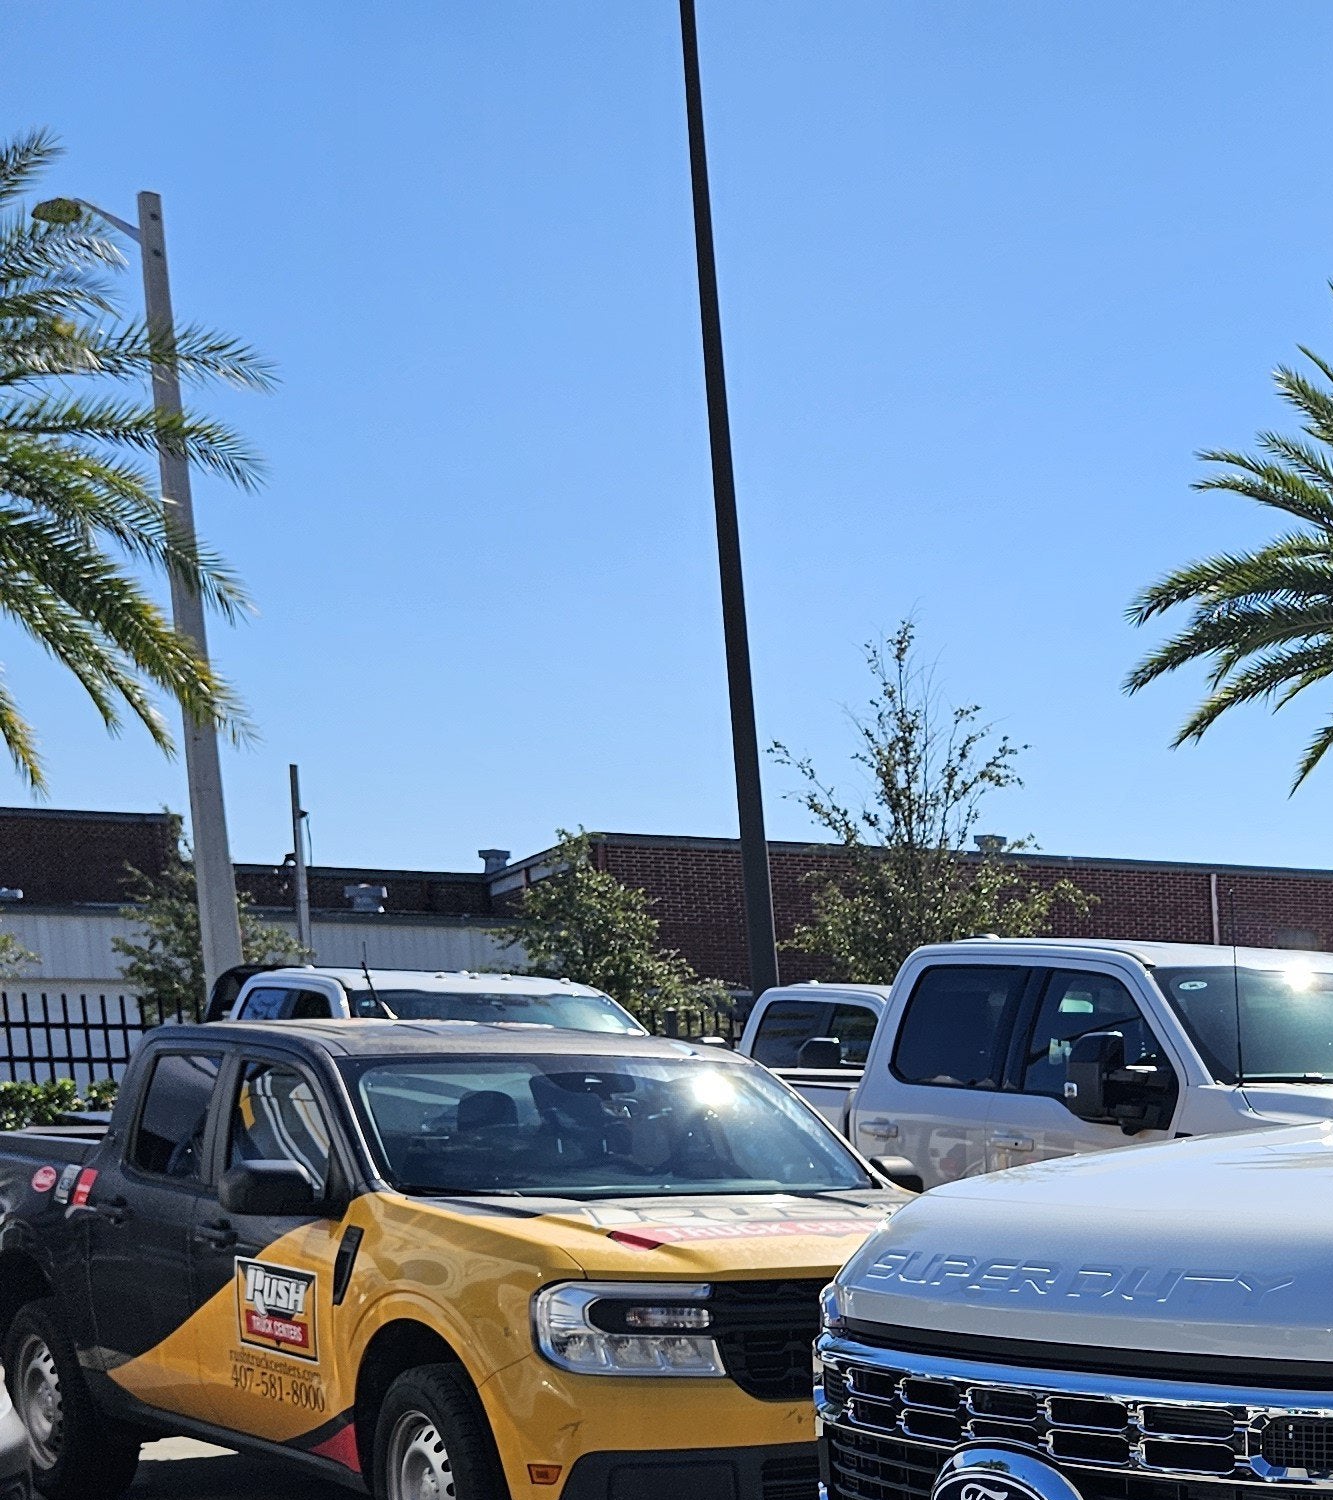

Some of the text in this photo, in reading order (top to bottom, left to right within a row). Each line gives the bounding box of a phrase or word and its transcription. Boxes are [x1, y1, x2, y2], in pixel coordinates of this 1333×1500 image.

[655, 1222, 793, 1241] TRUCK
[246, 1265, 308, 1316] RUSH
[866, 1249, 1296, 1305] SUPER DUTY
[251, 1315, 303, 1342] TRUCK CENTERS
[231, 1365, 325, 1412] 407-581-8000
